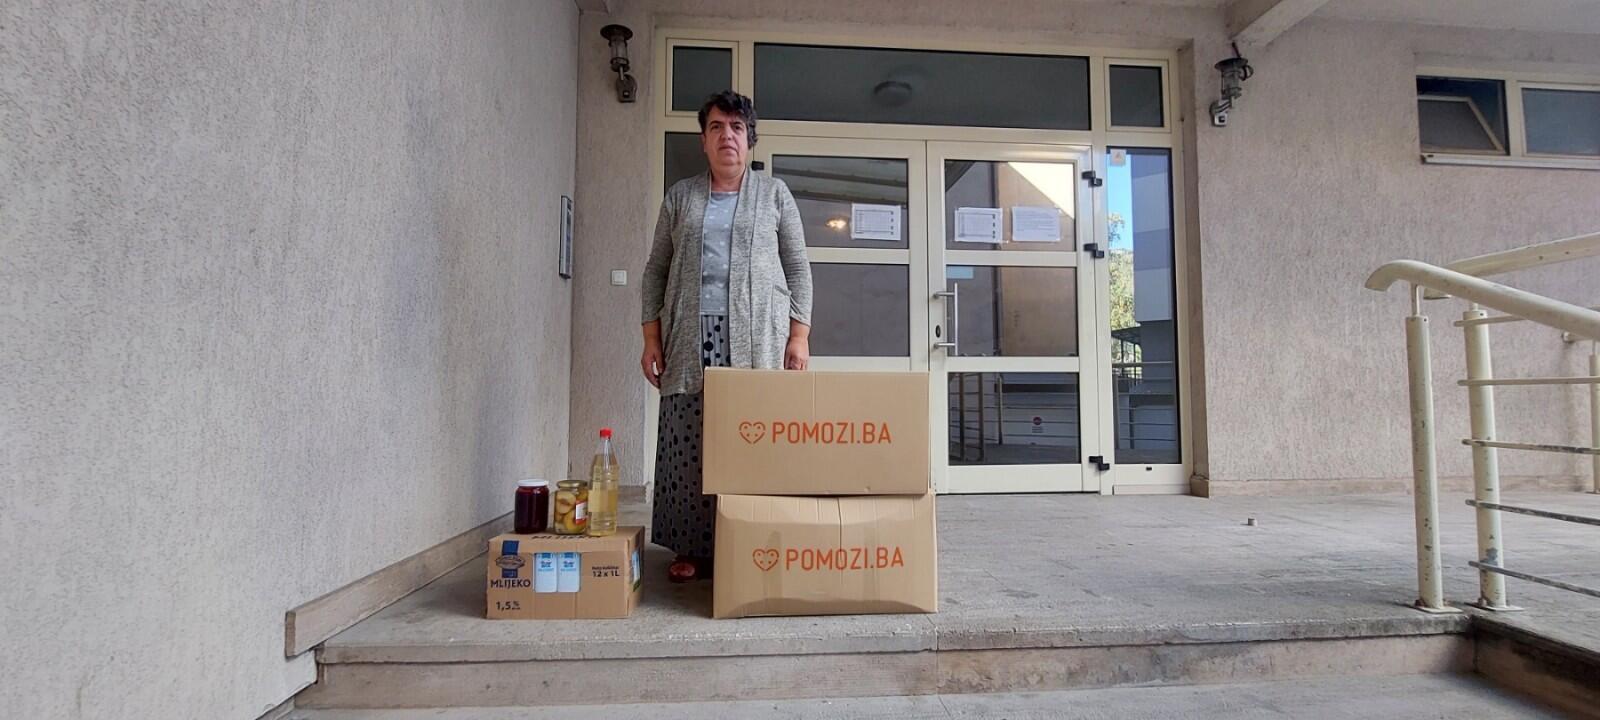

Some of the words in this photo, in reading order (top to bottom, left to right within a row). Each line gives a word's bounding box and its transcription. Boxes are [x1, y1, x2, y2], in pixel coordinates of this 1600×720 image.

[771, 421, 892, 445] POMOZI.BA
[785, 546, 905, 571] POMOZI.BA
[490, 579, 531, 589] MLIJEKO
